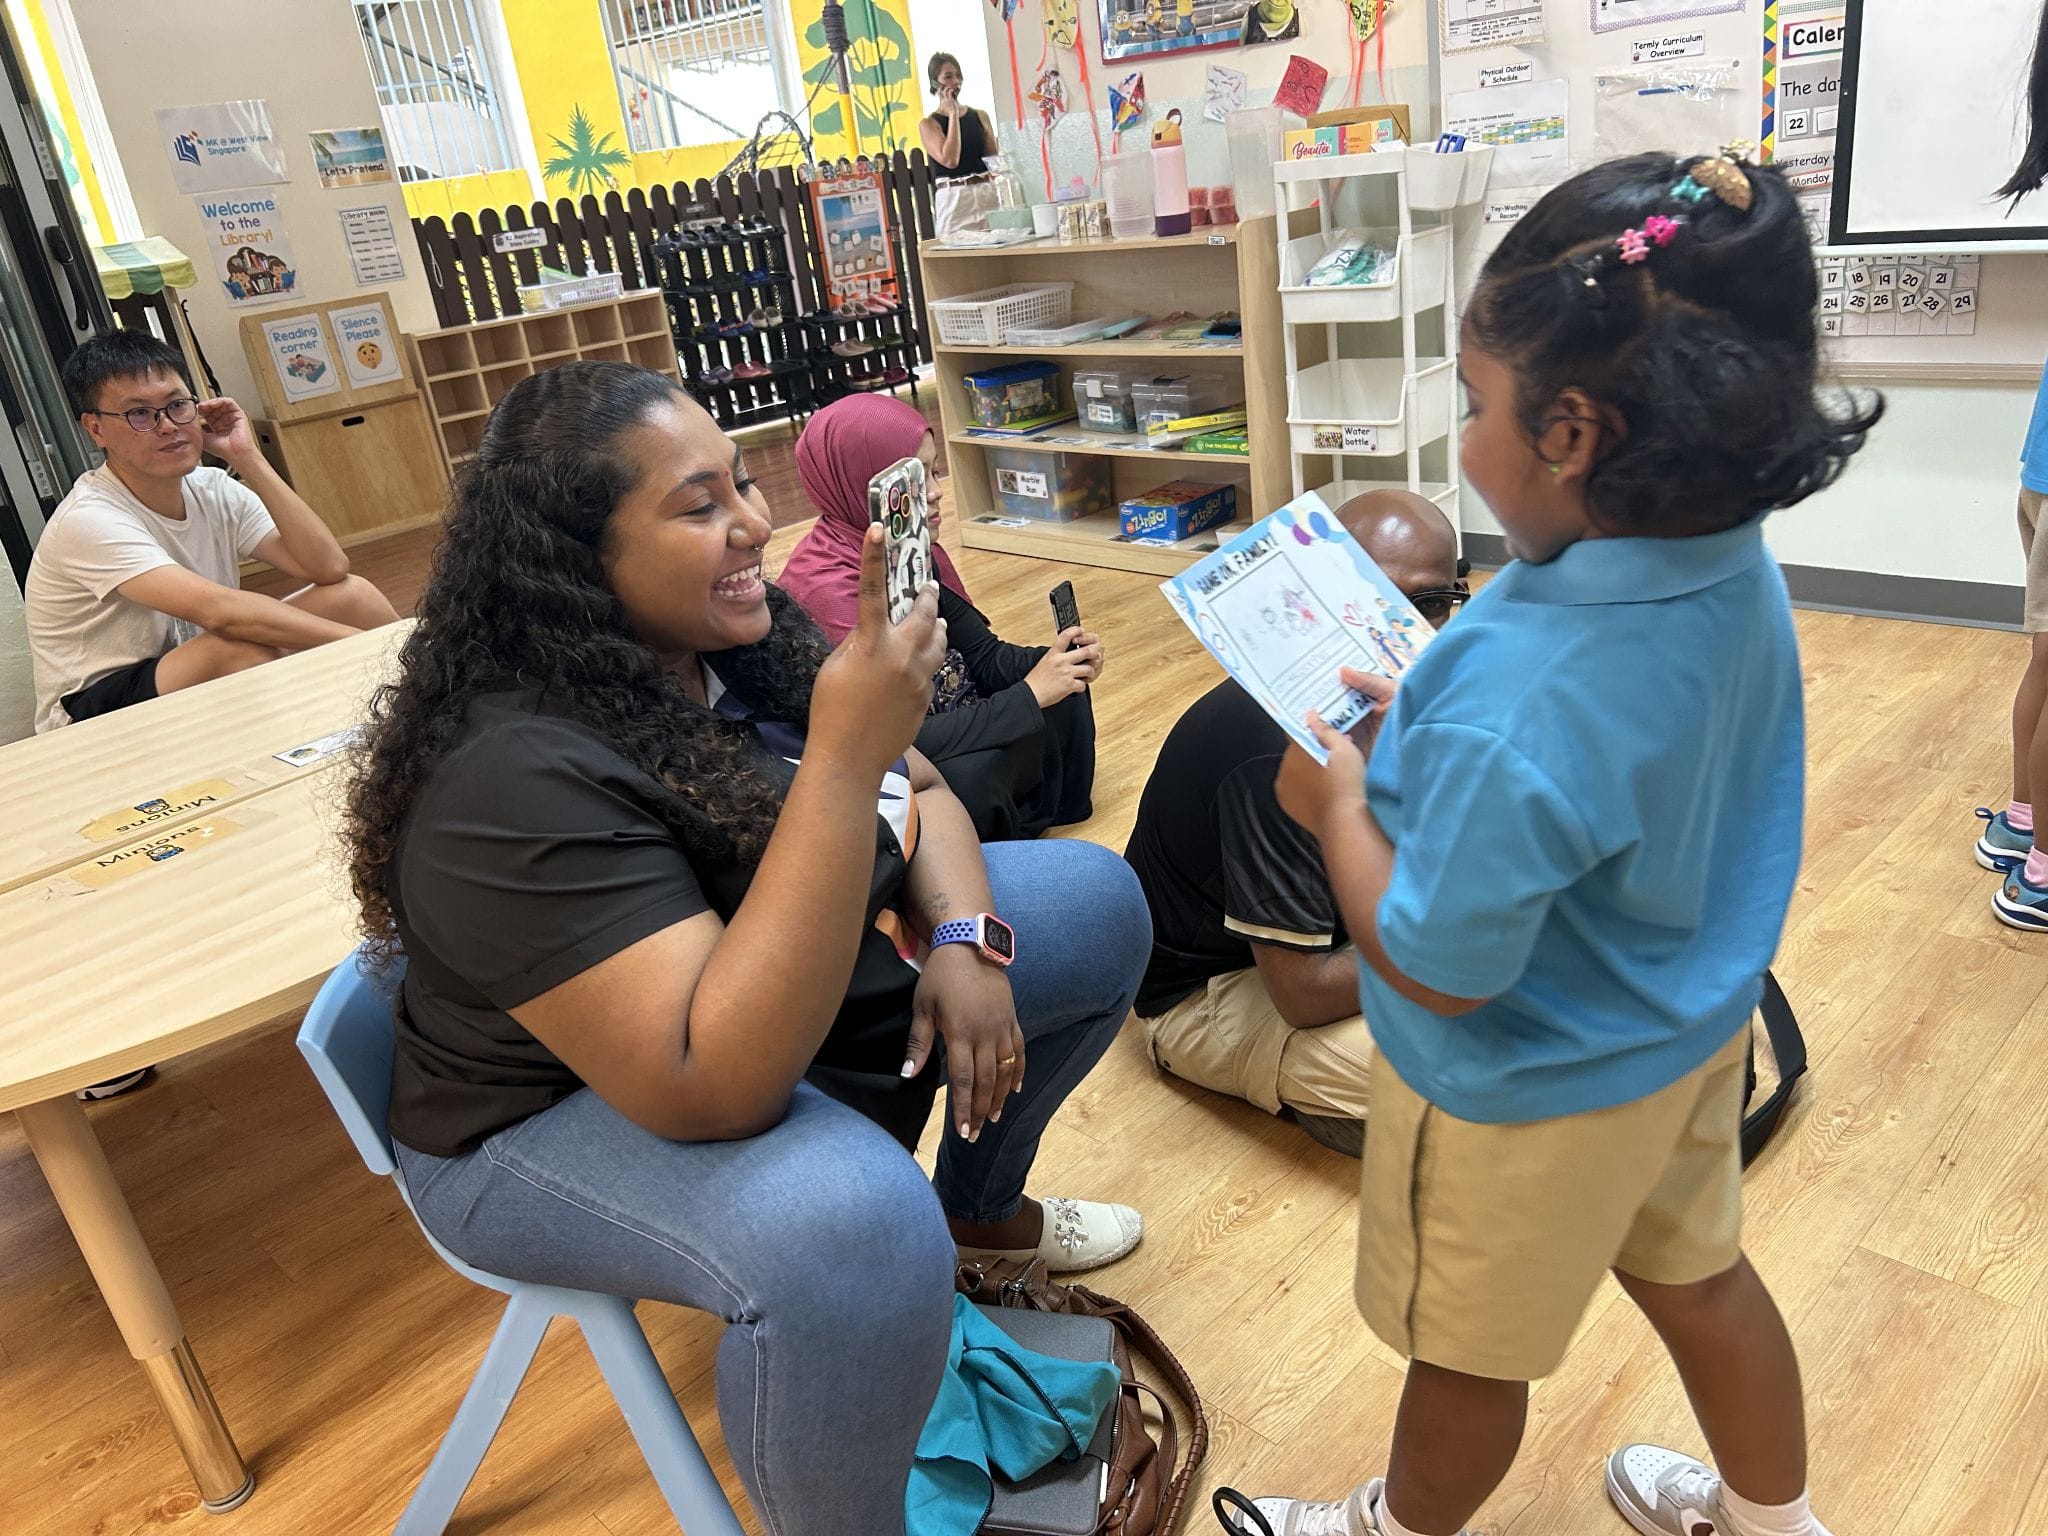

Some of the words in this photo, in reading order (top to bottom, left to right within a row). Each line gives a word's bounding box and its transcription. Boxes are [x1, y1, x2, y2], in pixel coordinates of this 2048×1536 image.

[1633, 40, 1659, 51] Termly
[1662, 34, 1703, 46] Curriculum
[1650, 48, 1685, 58] Overview
[1481, 67, 1504, 78] Physical
[1505, 64, 1530, 73] Outdoor
[1492, 74, 1518, 84] Schedule
[1781, 80, 1812, 96] The
[1789, 118, 1804, 129] 22
[206, 139, 218, 147] MK
[228, 136, 248, 145] West
[250, 135, 269, 144] View
[208, 146, 246, 156] Singapore
[1292, 140, 1331, 160] Beautex
[1775, 154, 1830, 168] Yesterday
[324, 167, 347, 178] Let's
[348, 162, 384, 175] Pretend
[1791, 174, 1830, 186] Monday
[202, 200, 276, 218] Welcome
[343, 211, 368, 220] Library
[220, 219, 235, 231] to
[238, 216, 261, 229] the
[219, 229, 274, 247] Library!
[1828, 273, 1837, 283] 17
[1852, 273, 1864, 284] 18
[1879, 274, 1891, 285] 19
[1902, 273, 1919, 287] 20
[1935, 273, 1947, 284] 21
[1823, 298, 1838, 309] 24
[1850, 295, 1866, 308] 25
[1873, 294, 1889, 306] 26
[1902, 294, 1916, 307] 27
[1923, 296, 1940, 311] 28
[1954, 295, 1971, 308] 29
[341, 316, 378, 330] Silence
[1825, 320, 1835, 331] 31
[272, 327, 318, 343] Reading
[345, 328, 381, 342] Please
[281, 339, 318, 354] corner
[1344, 427, 1370, 436] Water
[1345, 437, 1370, 446] bottle
[1192, 494, 1222, 528] Zingo!
[1131, 509, 1168, 531] Zingo!
[116, 795, 217, 833] Minions
[96, 825, 201, 867] Minions
